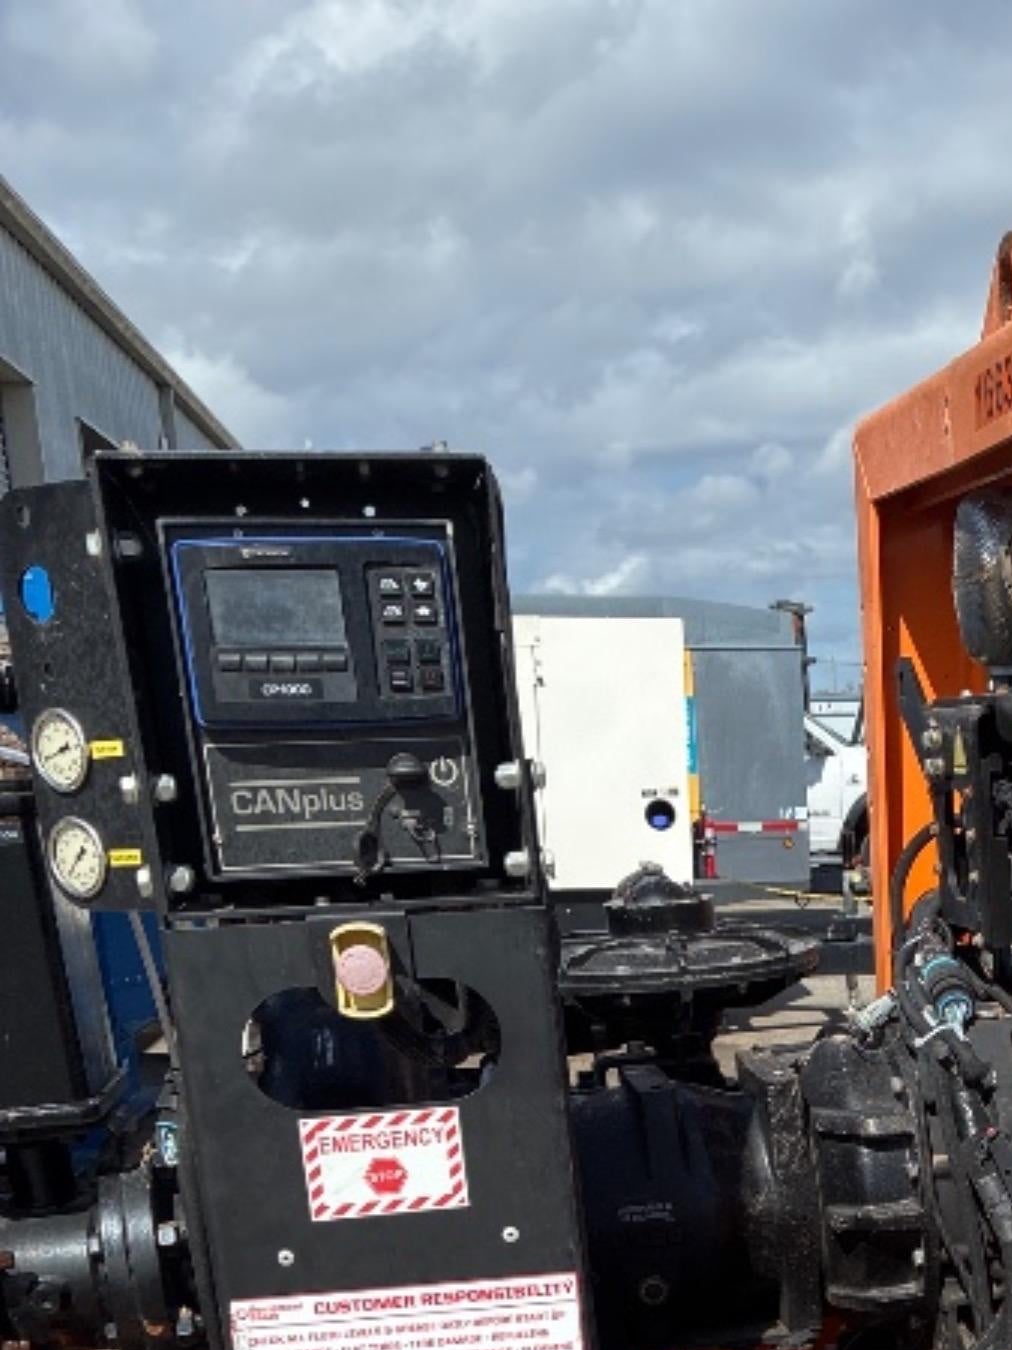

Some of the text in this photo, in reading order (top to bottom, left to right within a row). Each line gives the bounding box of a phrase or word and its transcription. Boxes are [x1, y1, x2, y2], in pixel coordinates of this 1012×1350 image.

[231, 788, 364, 819] CANplus
[319, 1127, 444, 1156] EMERGENCY
[312, 1294, 415, 1316] CUSTOMER
[420, 1279, 573, 1306] RESPONSIBILITY
